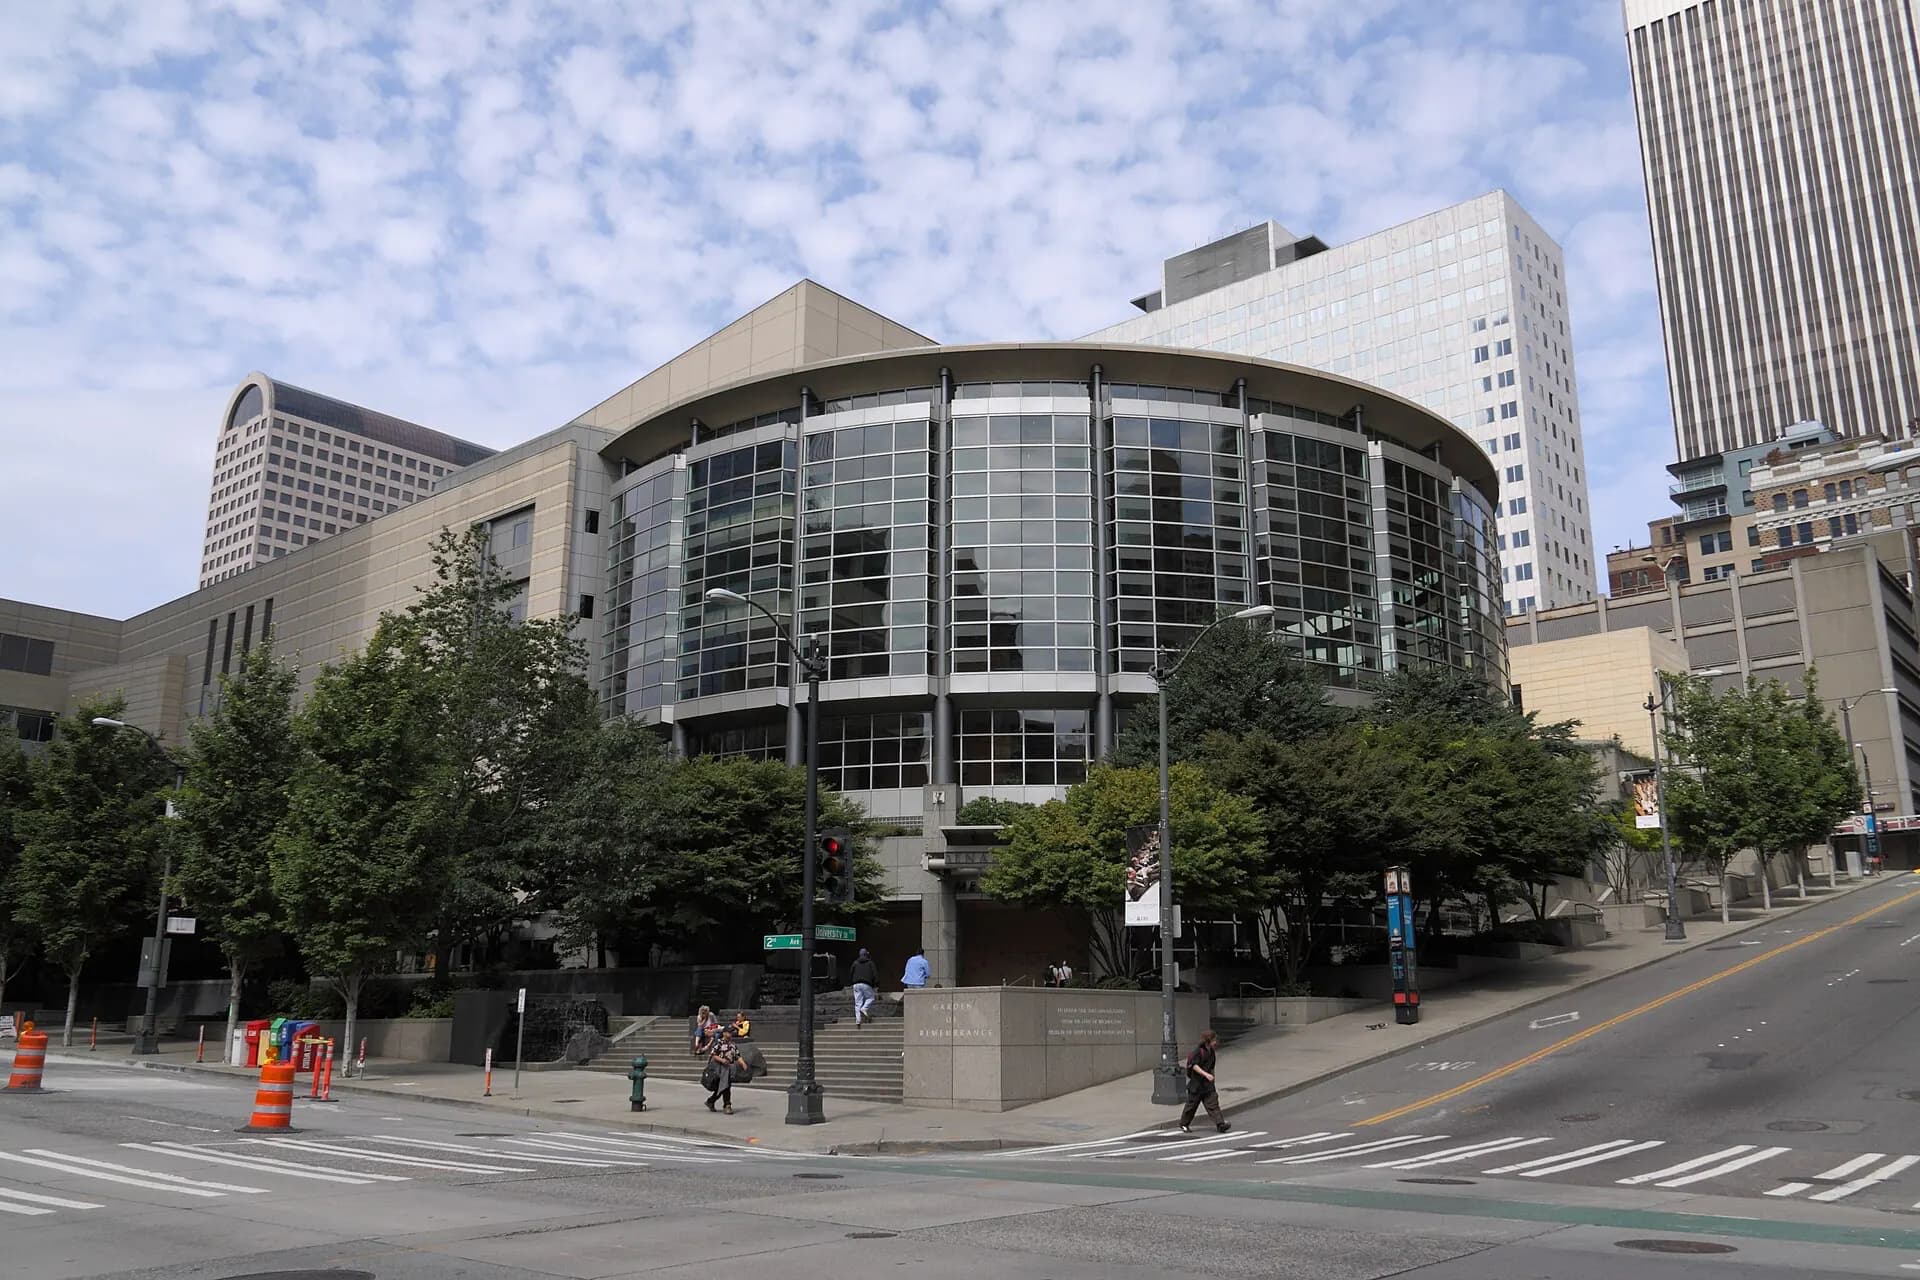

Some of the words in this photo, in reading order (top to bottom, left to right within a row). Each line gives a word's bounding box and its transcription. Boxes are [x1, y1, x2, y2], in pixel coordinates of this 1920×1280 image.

[815, 927, 843, 939] University
[789, 937, 800, 945] Ave
[932, 1002, 973, 1010] GARDEN
[919, 1028, 993, 1037] REMEMBRANCE
